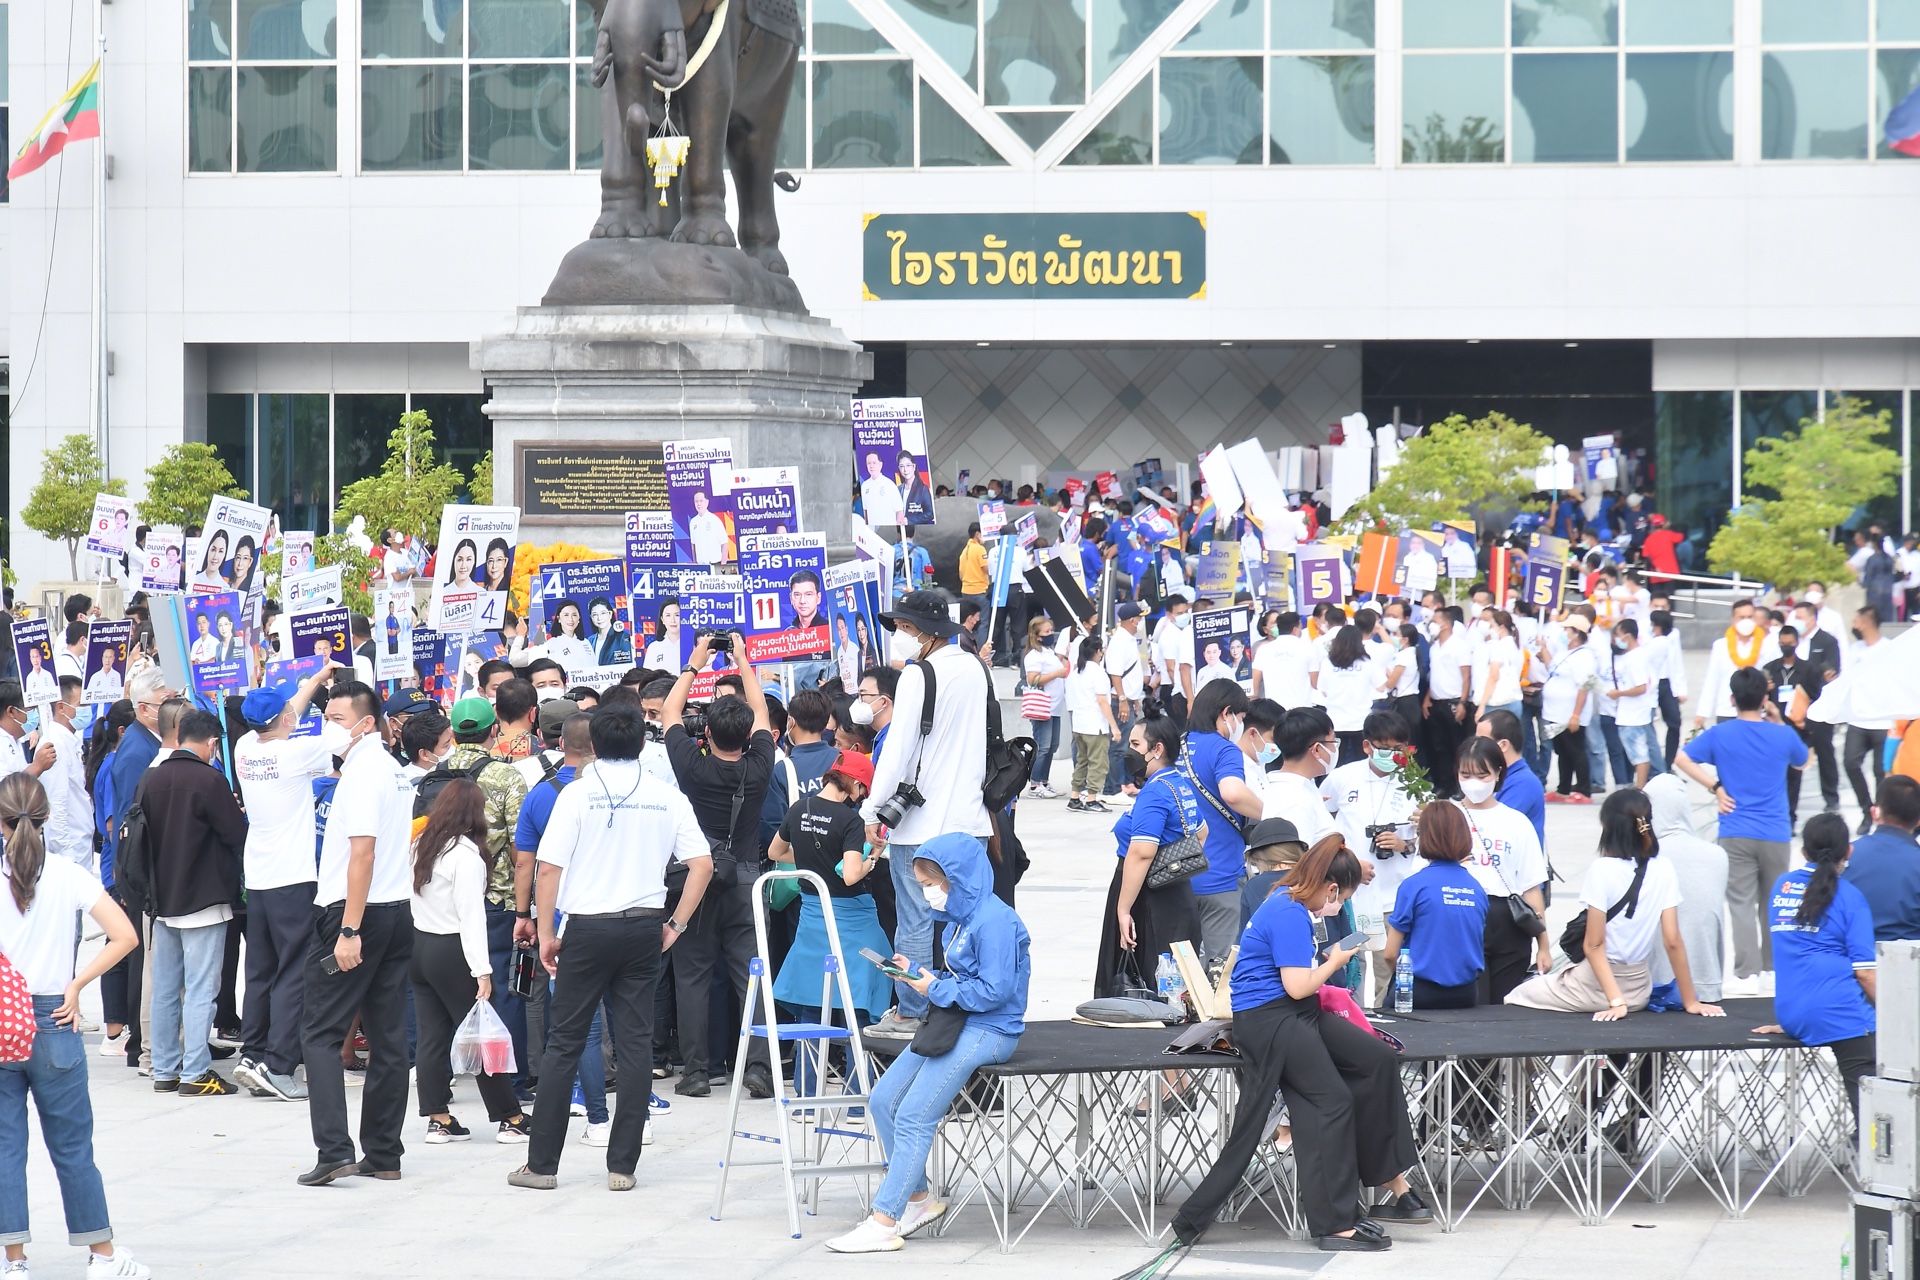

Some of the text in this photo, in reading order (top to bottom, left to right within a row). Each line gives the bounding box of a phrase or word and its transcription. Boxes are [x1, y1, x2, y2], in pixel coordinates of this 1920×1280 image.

[865, 406, 921, 418] ไทยสร้างไทย
[676, 448, 731, 461] ไทยสร้างไทย
[737, 487, 791, 510] เดินหน้า
[98, 518, 109, 531] 6
[227, 513, 263, 531] ไทยสร้างไทย
[471, 521, 513, 531] ไทยสร้างไทย
[997, 515, 1003, 523] 5
[762, 537, 819, 549] ไทยสร้างไทย
[1530, 532, 1541, 548] 5
[1201, 541, 1211, 556] 5
[150, 556, 160, 569] 6
[289, 555, 298, 567] 6
[795, 556, 819, 568] ทิวารี
[1038, 550, 1050, 563] 5
[1262, 550, 1270, 564] 5
[567, 564, 621, 577] ดร.รัตติกาล
[1206, 569, 1228, 580] เลือก
[1437, 561, 1446, 575] 5
[832, 570, 861, 585] ไทยสร้างไทย
[1394, 569, 1405, 584] 5
[544, 572, 566, 598] 4
[568, 584, 611, 595] #ทีมสุดารัตน์
[633, 573, 654, 599] 4
[1159, 583, 1166, 598] 5
[1311, 570, 1333, 599] 5
[1533, 575, 1553, 605] 5
[444, 602, 472, 618] เมลิสา
[480, 598, 498, 624] 4
[755, 597, 774, 621] 11
[306, 612, 348, 626] คนทำงาน
[1195, 617, 1230, 629] อิทธิพล
[22, 621, 48, 635] คนทำงาน
[102, 623, 130, 635] คนทำงาน
[332, 632, 346, 652] 3
[40, 641, 51, 660] 3
[117, 643, 127, 661] 3
[588, 793, 627, 803] ไทยสร้งไทย
